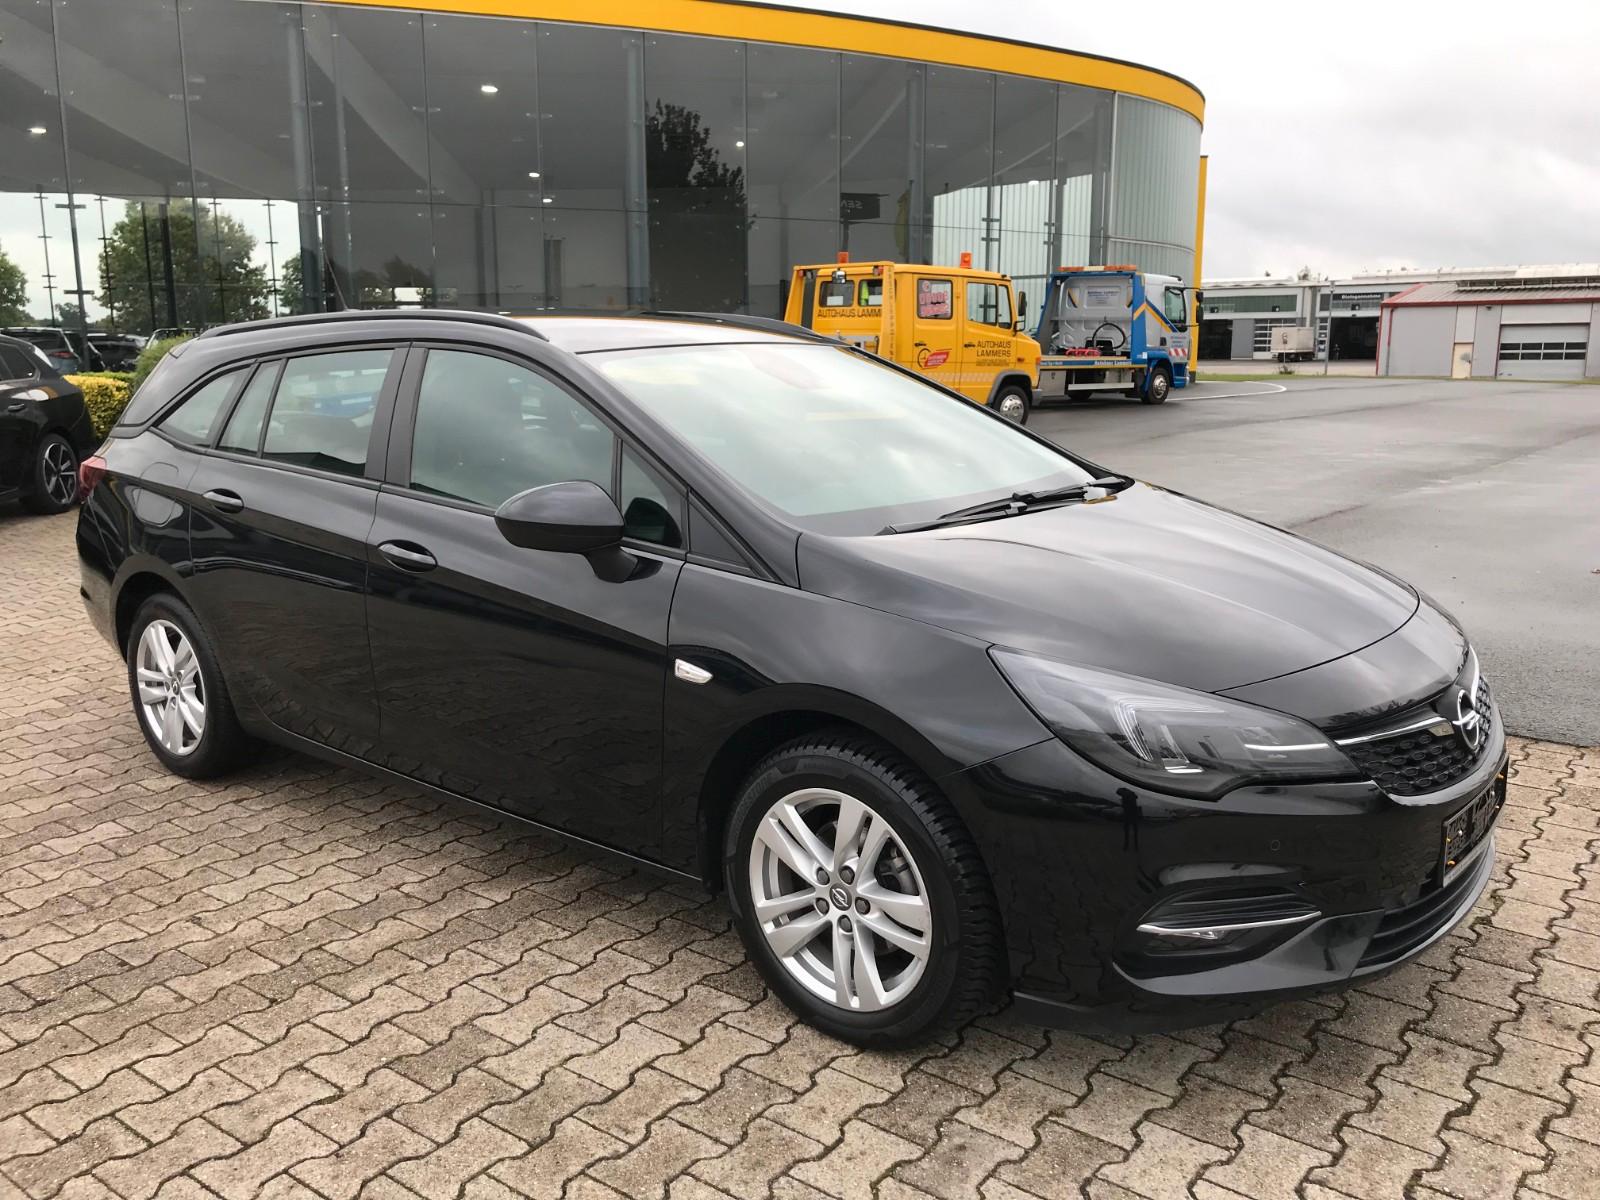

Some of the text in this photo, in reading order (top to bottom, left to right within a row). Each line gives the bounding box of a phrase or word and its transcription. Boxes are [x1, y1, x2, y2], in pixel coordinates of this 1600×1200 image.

[817, 308, 882, 318] AUTOHAUS LAMM
[977, 340, 1012, 349] AUTOHAUS
[976, 349, 1012, 358] LAMMERS
